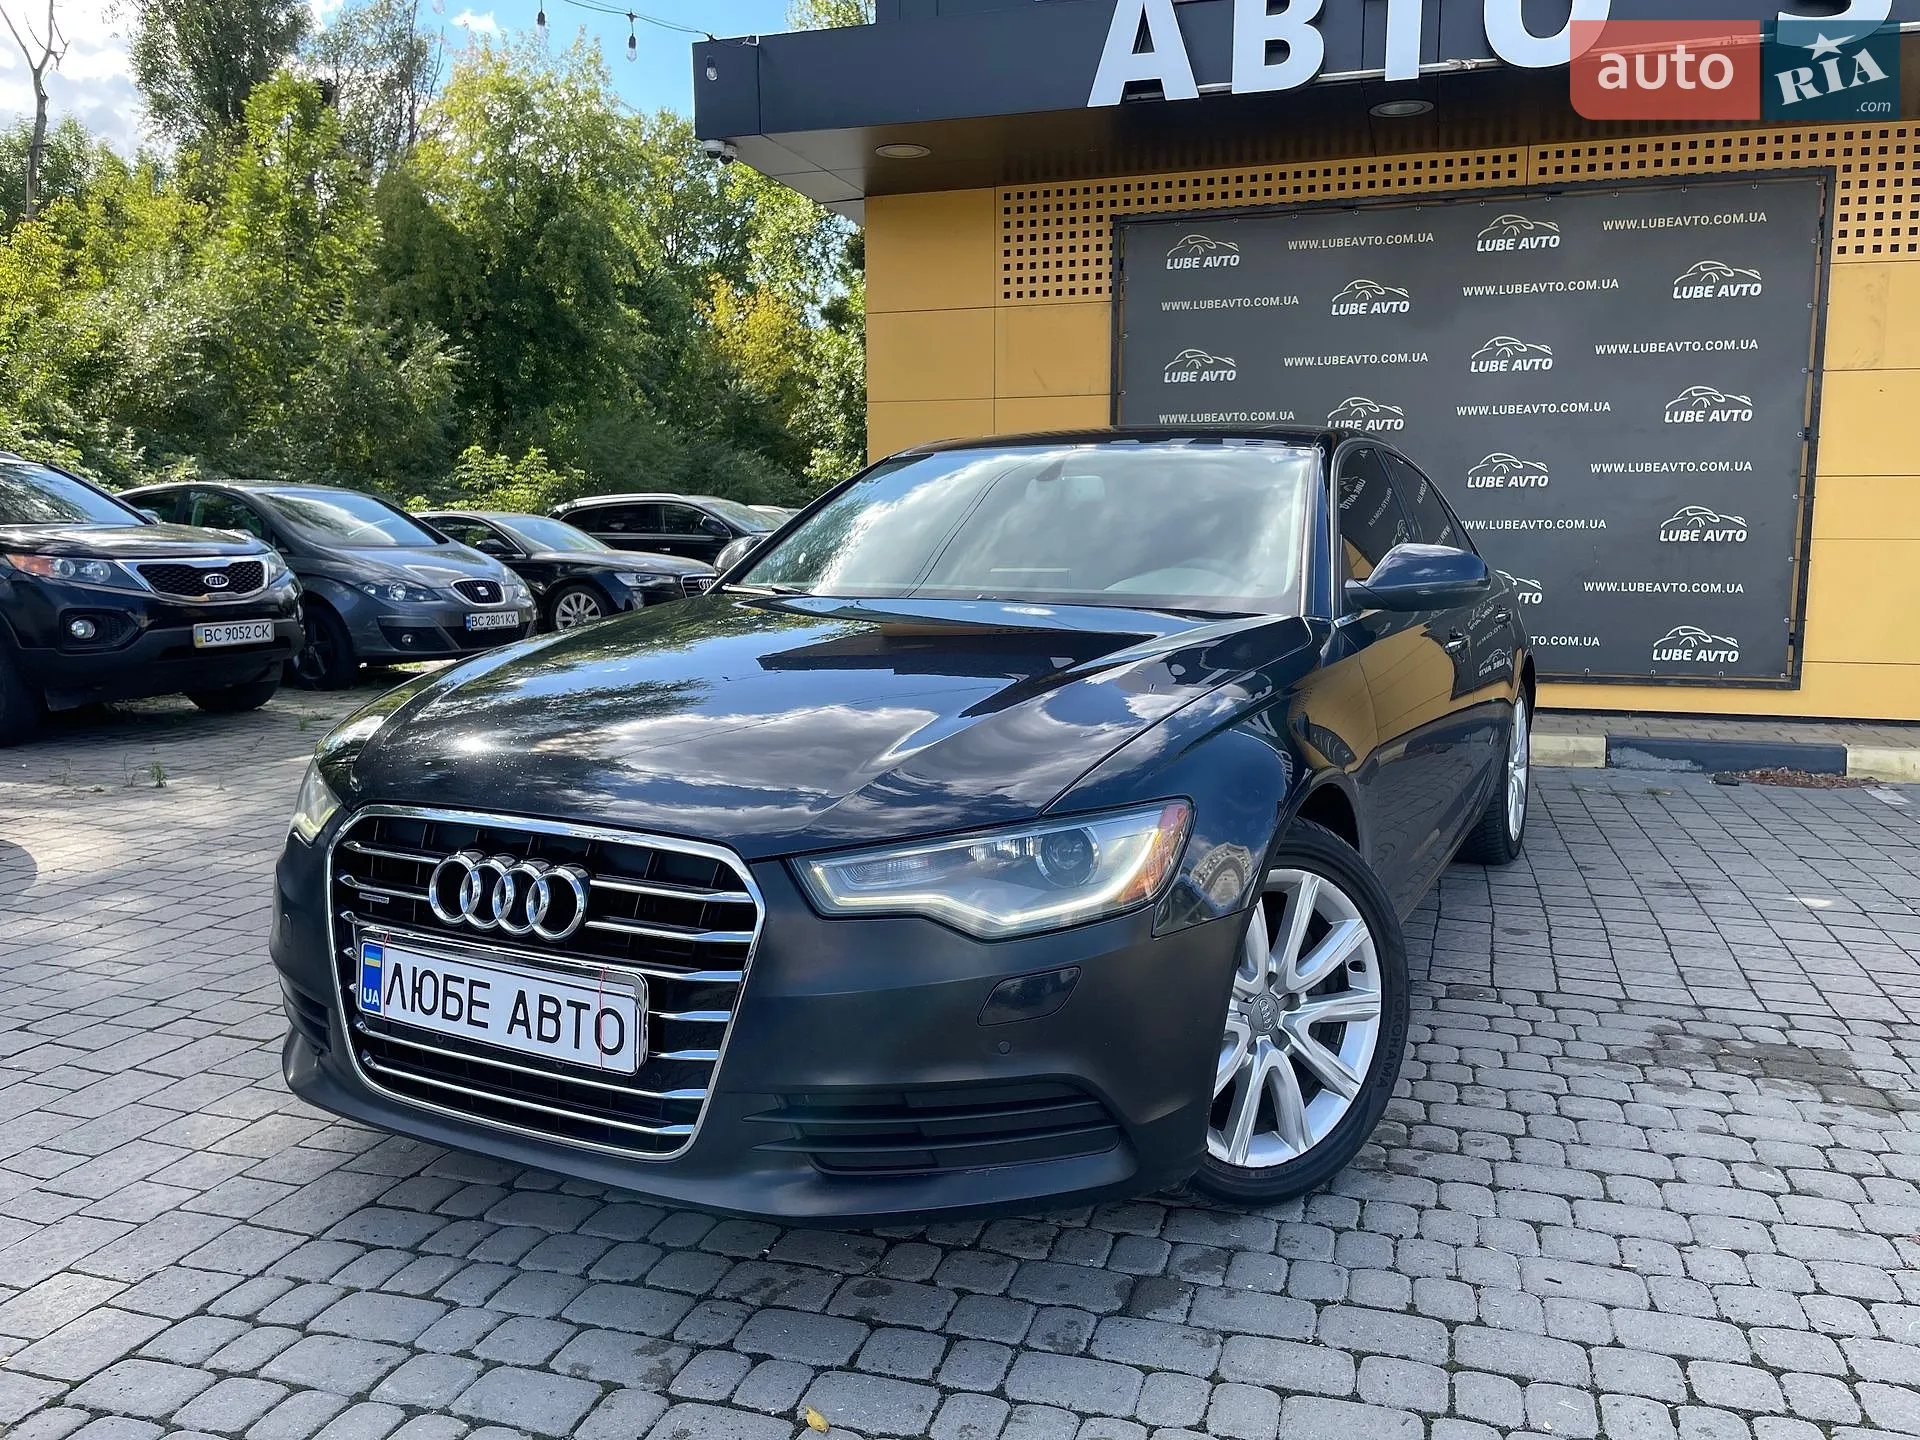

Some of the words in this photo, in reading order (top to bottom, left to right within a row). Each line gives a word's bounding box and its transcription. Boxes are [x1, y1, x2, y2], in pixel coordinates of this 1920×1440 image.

[1603, 212, 1766, 230] WWW.LUBEAVTO.COM.UA
[1288, 233, 1434, 250] WWW.LUBEAVTO.COM.UA
[1477, 237, 1515, 251] LUBE
[1518, 235, 1560, 249] AVTO
[1167, 257, 1200, 269] LUBE
[1203, 255, 1240, 267] AVTO
[1463, 279, 1619, 296] WWW.LUBEAVTO.COM.UA
[1673, 284, 1714, 300] LUBE
[1717, 283, 1762, 297] AVTO
[1161, 296, 1299, 310] WWW.LUBEAVTO.COM.UA
[1331, 303, 1368, 315] LUBE
[1370, 301, 1409, 314] AVTO
[1595, 339, 1758, 354] WWW.LUBEAVTO.COM.UA
[1284, 353, 1428, 367] WWW.LUBEAVTO.COM.UA
[1471, 358, 1509, 372] LUBE
[1512, 356, 1553, 371] AVTO
[1164, 371, 1198, 383] LUBE
[1200, 370, 1236, 381] AVTO
[1457, 402, 1611, 416] WWW.LUBEAVTO.COM.UA
[1665, 409, 1705, 423] LUBE
[1708, 409, 1752, 422] AVTO
[1159, 411, 1294, 425] WWW.LUBEAVTO.COM.UA
[1365, 418, 1404, 431] AVTO
[1591, 461, 1752, 473] WWW.LUBEAVTO.COM.UA
[1467, 476, 1505, 488] LUBE
[1508, 475, 1549, 487] AVTO
[1660, 530, 1700, 542] LUBE
[1703, 529, 1748, 542] AVTO
[1583, 582, 1744, 594] WWW.LUBEAVTO.COM.UA
[471, 615, 485, 627] BC
[486, 614, 505, 626] 2801
[204, 628, 222, 643] BC
[225, 626, 251, 641] 9052
[254, 623, 270, 639] CK
[1531, 634, 1600, 647] TO.COM.UA
[1653, 648, 1694, 662] LUBE
[1696, 649, 1739, 663] AVTO
[363, 987, 380, 1007] UA
[386, 963, 491, 1029] ЛЮБЕ
[507, 990, 625, 1056] АВТО
